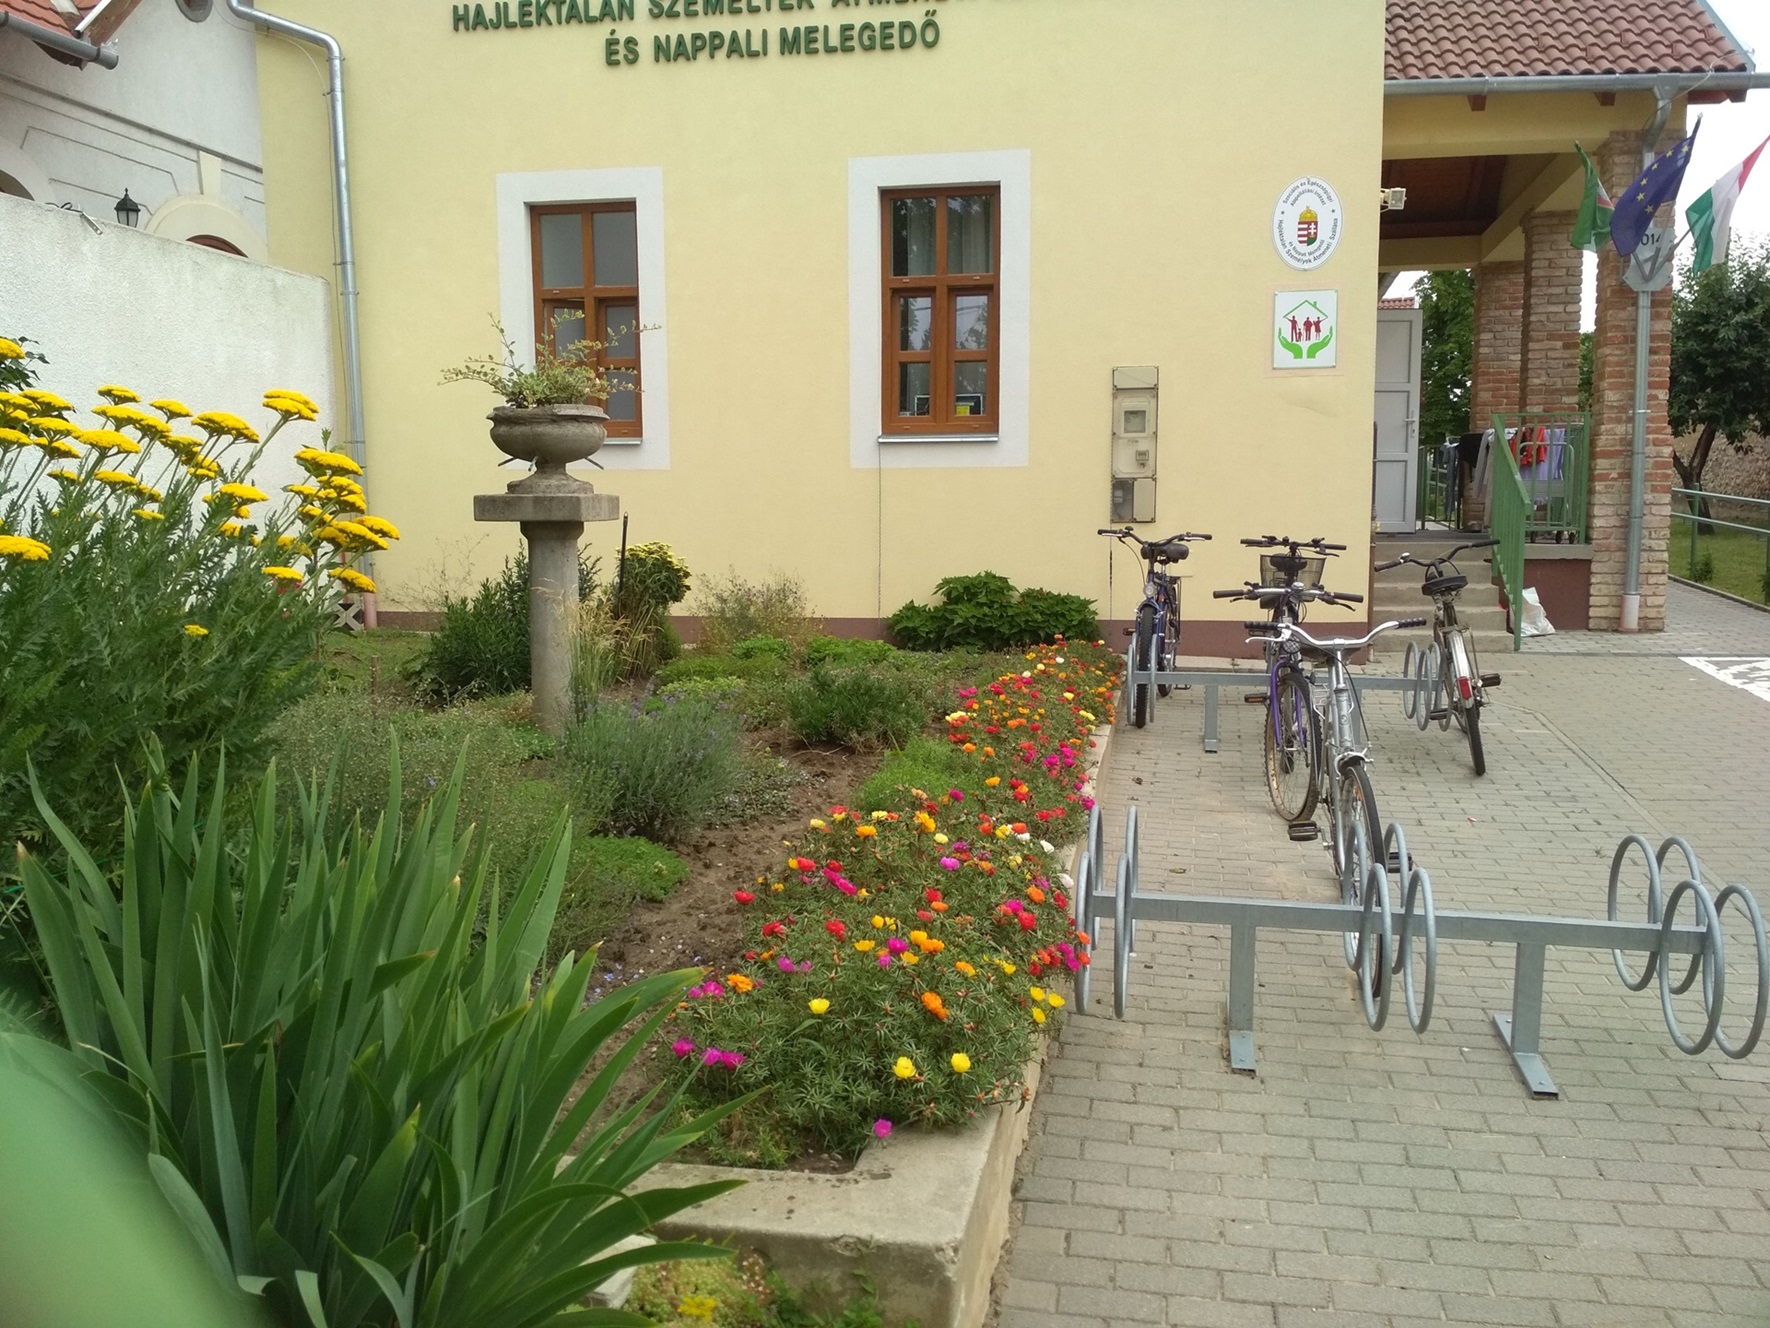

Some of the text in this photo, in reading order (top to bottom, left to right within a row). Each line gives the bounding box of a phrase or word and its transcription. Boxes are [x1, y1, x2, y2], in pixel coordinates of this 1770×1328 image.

[605, 10, 941, 66] ÉS NAPPALI MELEGEDŐ
